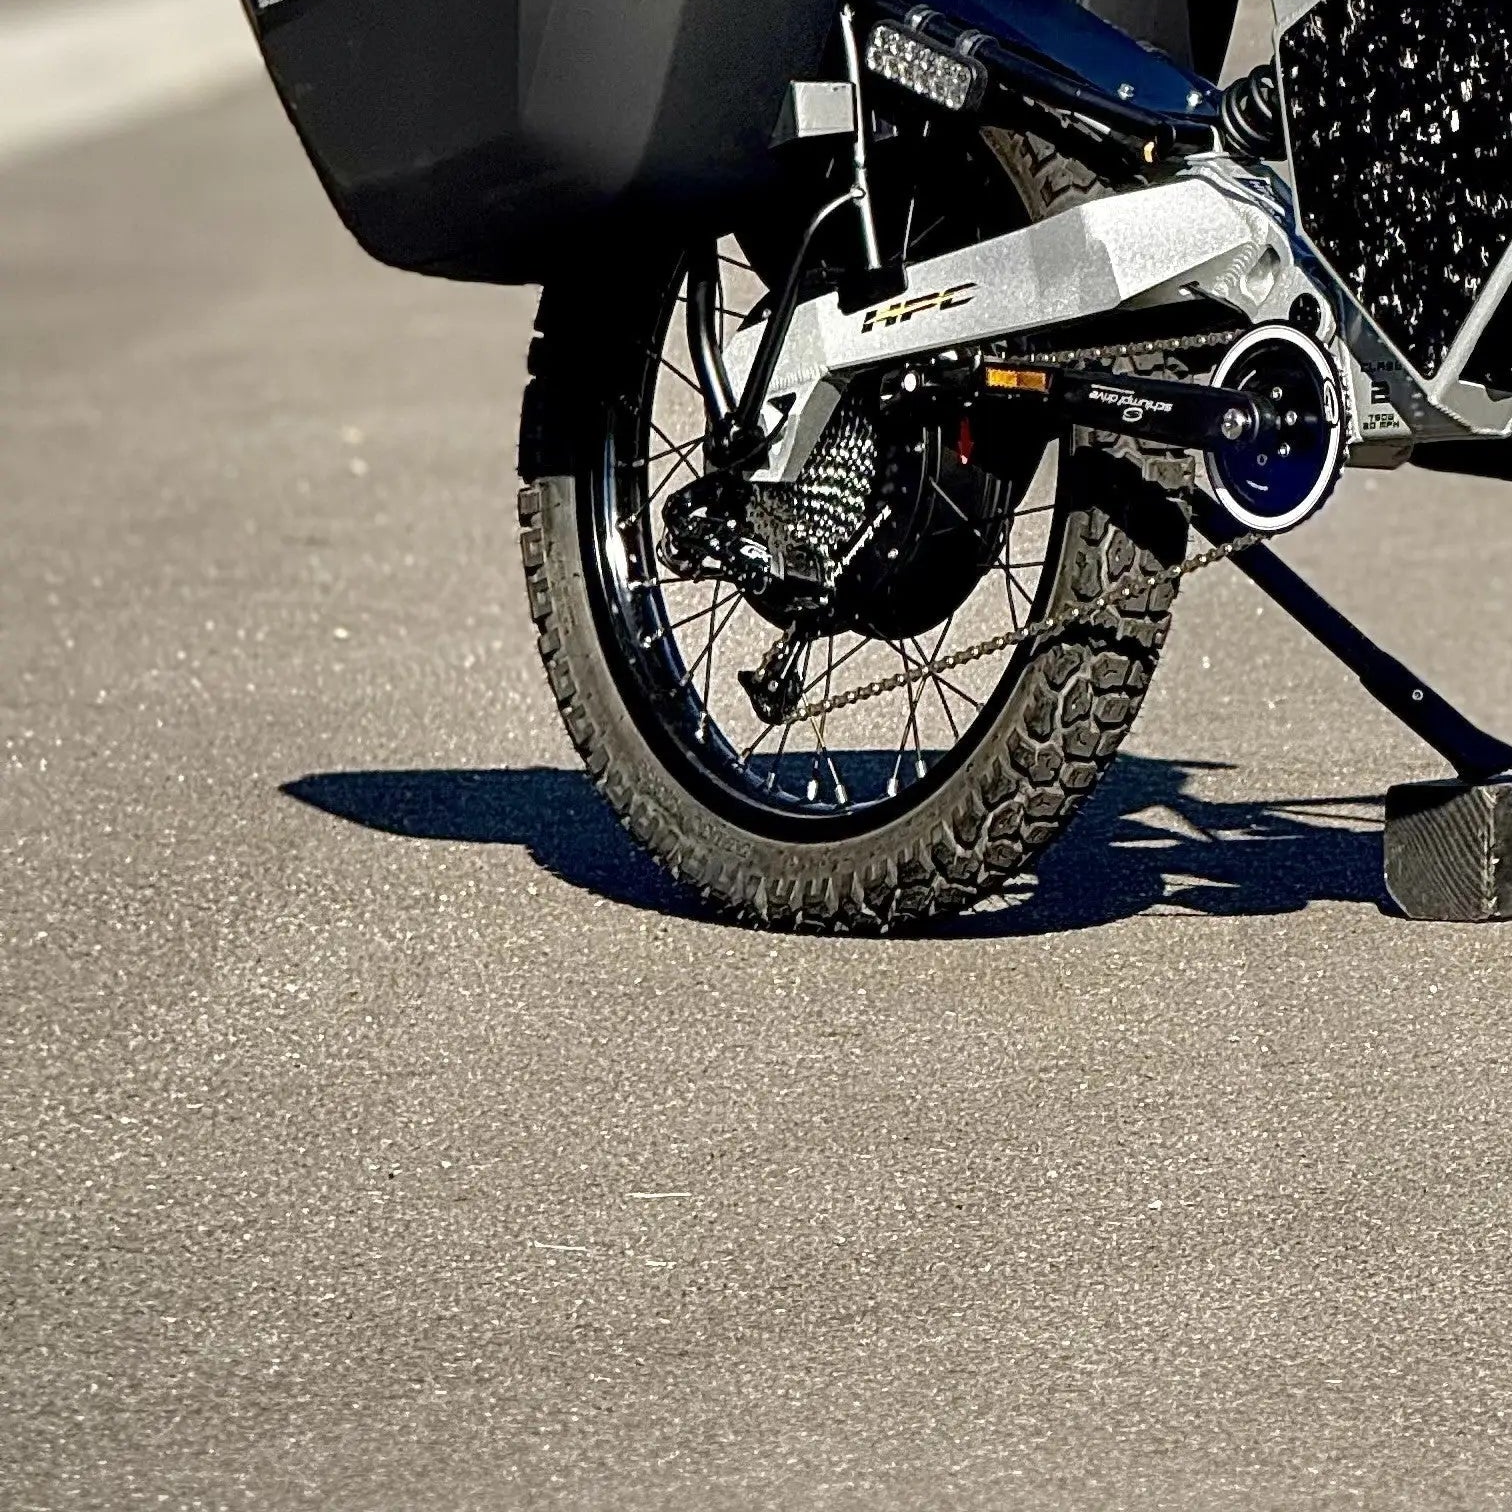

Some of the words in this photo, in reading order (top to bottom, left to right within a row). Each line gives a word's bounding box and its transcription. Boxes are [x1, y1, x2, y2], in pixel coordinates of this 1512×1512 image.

[861, 282, 978, 334] HPC
[1088, 390, 1119, 405] drive
[1371, 380, 1391, 404] 2
